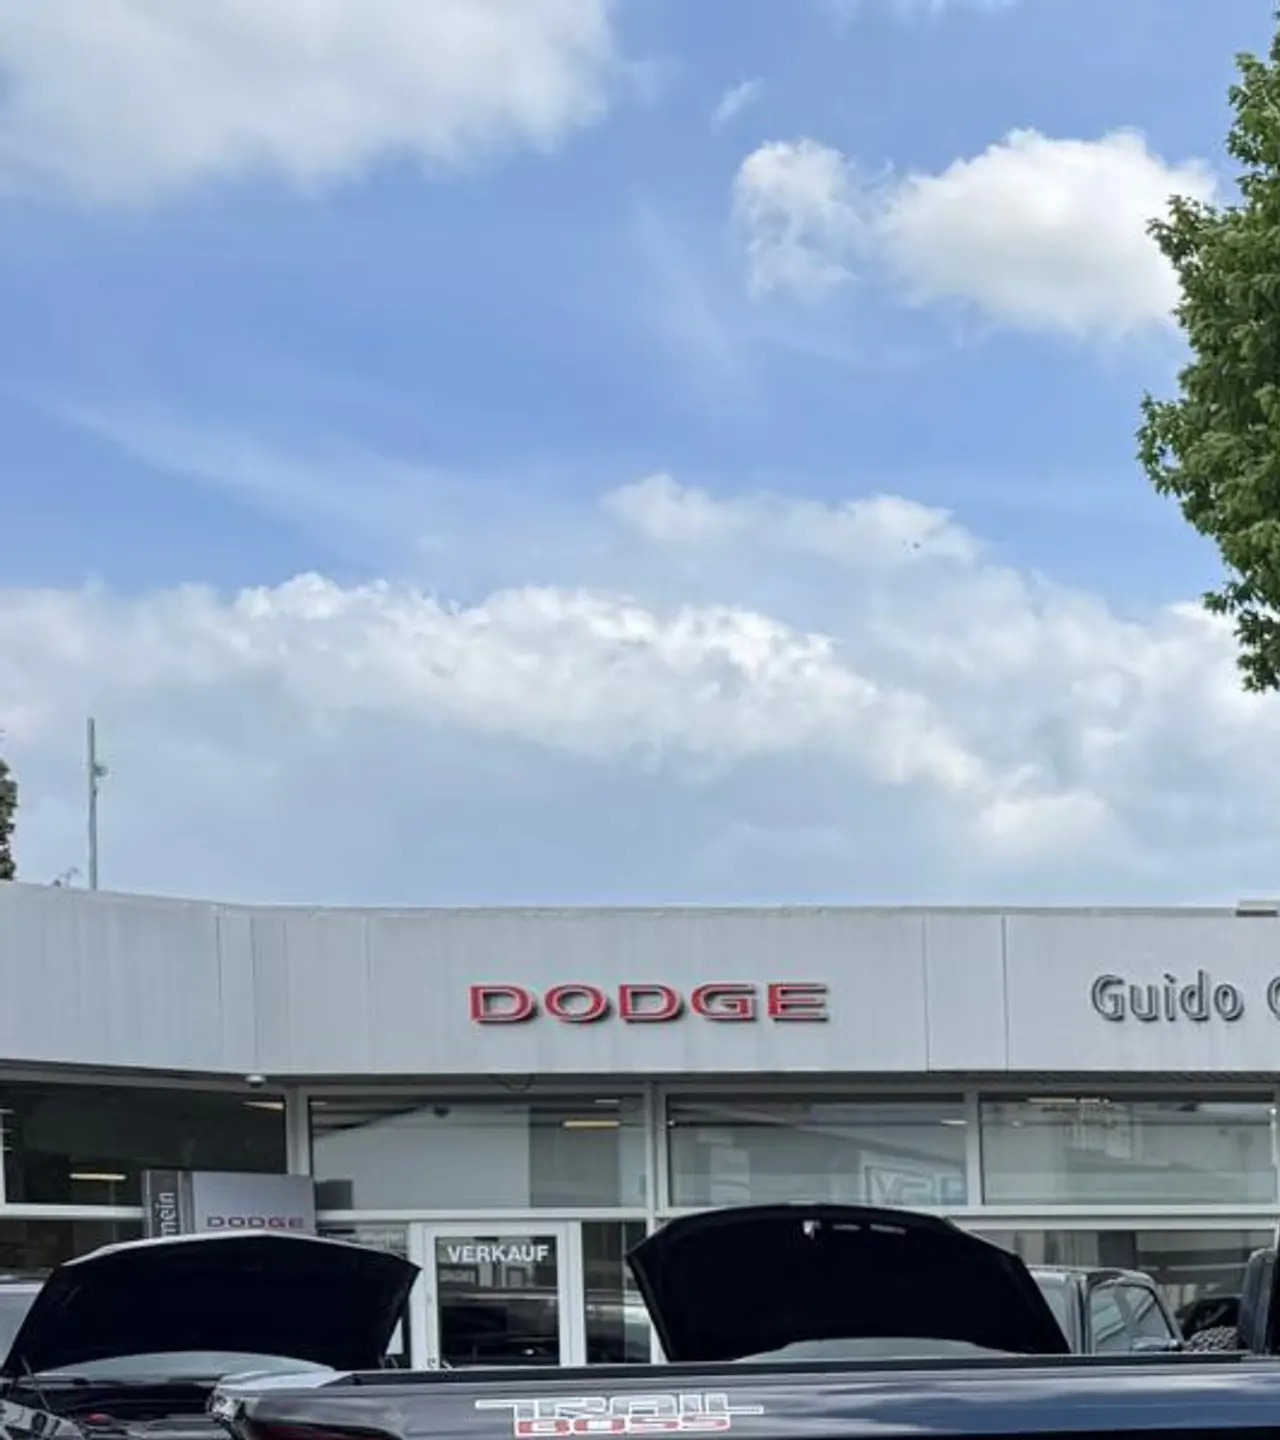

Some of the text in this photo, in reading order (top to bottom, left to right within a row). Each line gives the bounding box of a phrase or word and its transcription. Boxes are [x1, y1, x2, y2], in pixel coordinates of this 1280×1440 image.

[469, 984, 829, 1023] DODGE
[1091, 969, 1243, 1022] Guido
[206, 1215, 305, 1228] DODGE
[446, 1244, 550, 1264] VERKAUF
[474, 1393, 765, 1420] TRAIL
[513, 1414, 731, 1438] BOSS
